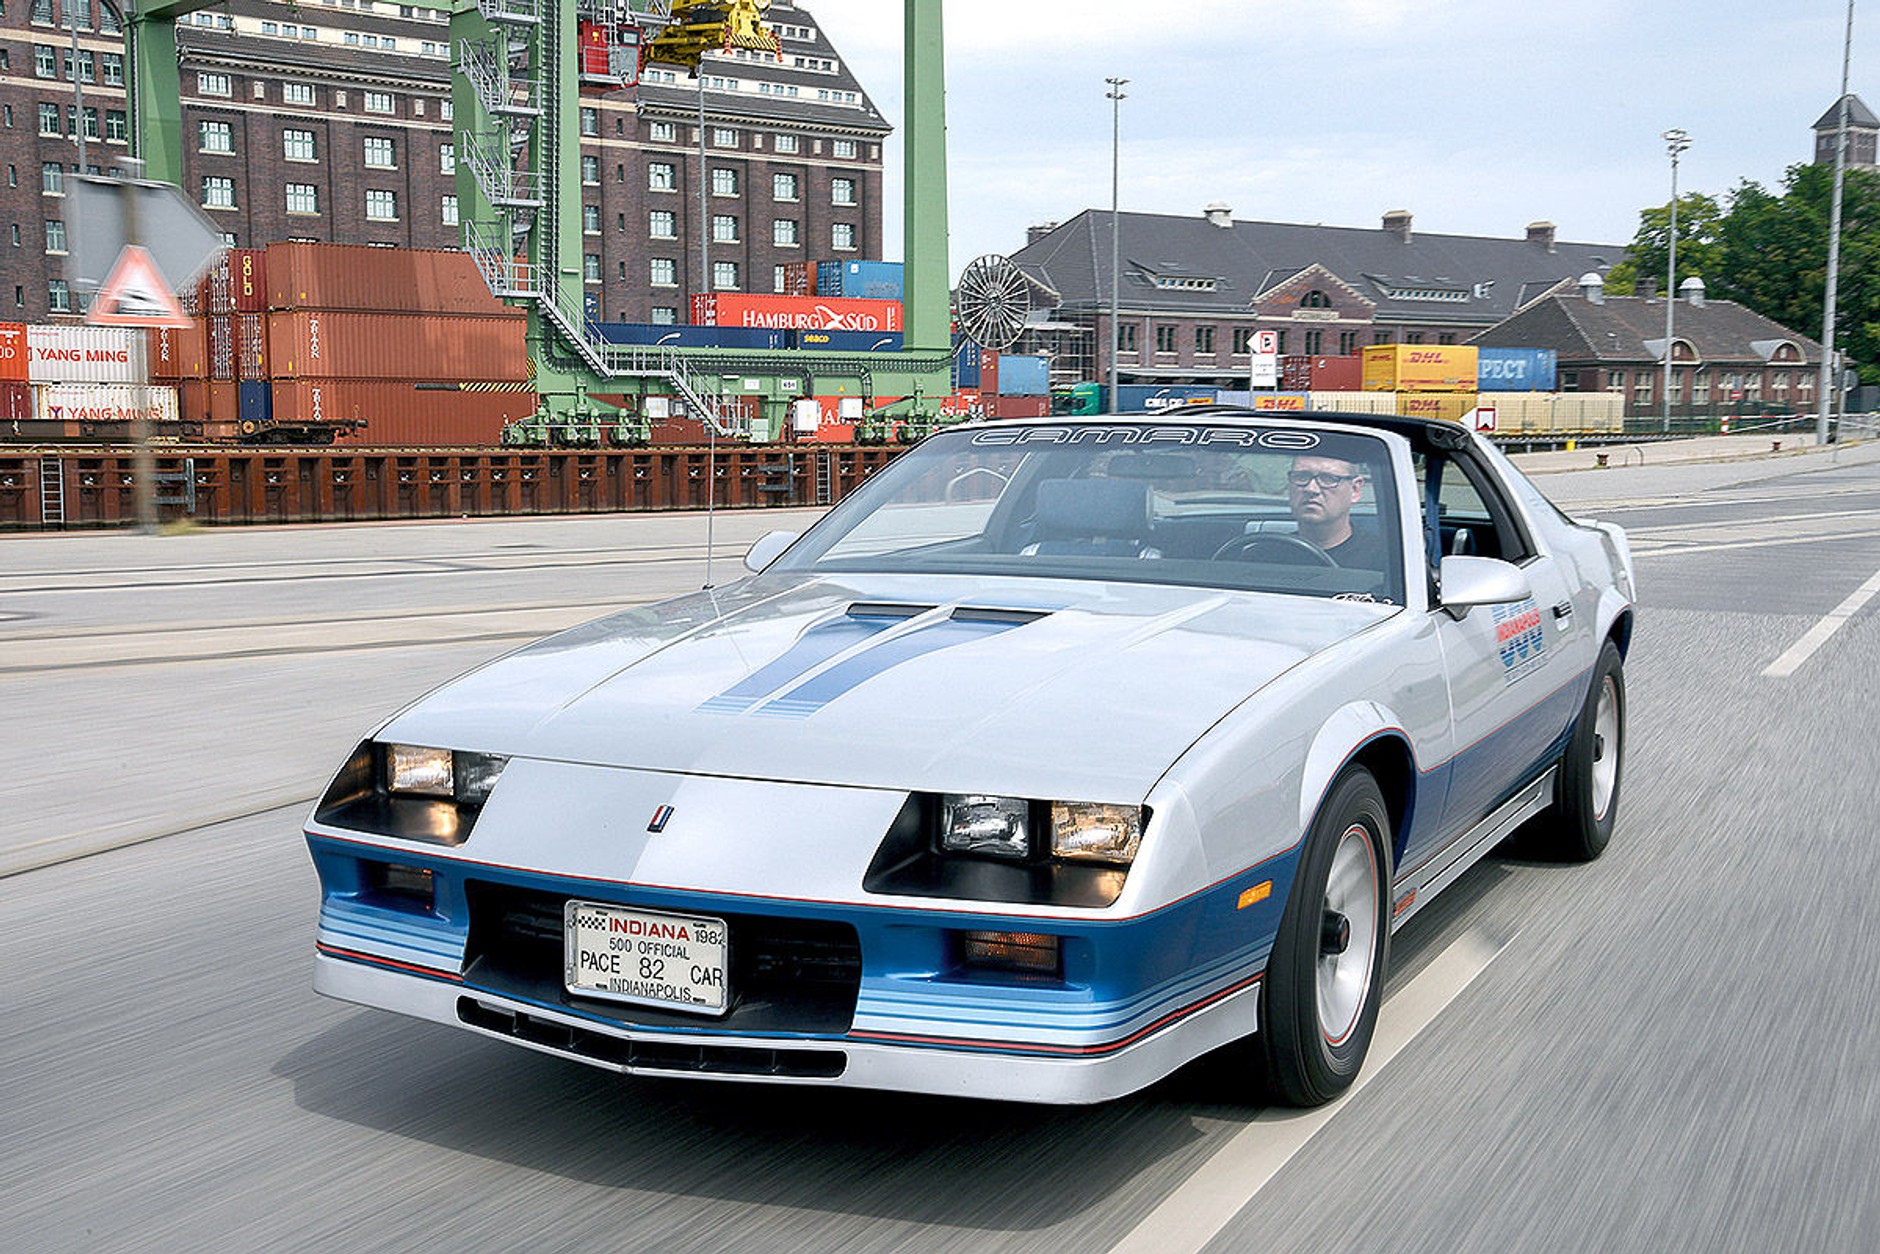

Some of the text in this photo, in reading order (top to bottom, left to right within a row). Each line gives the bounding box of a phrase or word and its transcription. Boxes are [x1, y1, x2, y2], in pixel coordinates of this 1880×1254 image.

[243, 255, 253, 296] GOLD
[742, 310, 821, 329] HAMBURG
[845, 312, 878, 331] SÜD
[36, 348, 128, 363] YANG MING
[1409, 352, 1444, 364] DHL
[1478, 359, 1527, 379] PECT
[68, 407, 112, 420] YANG
[311, 388, 322, 420] TRITO
[1262, 399, 1298, 410] DHL
[1408, 399, 1441, 411] DHL
[971, 426, 1321, 450] CAMARO
[609, 917, 726, 945] INDIANA 1982
[609, 938, 690, 960] 500 OFFICIAL
[580, 950, 723, 987] PACE 82 CAR
[609, 977, 692, 1002] INDIANAPOLIS
